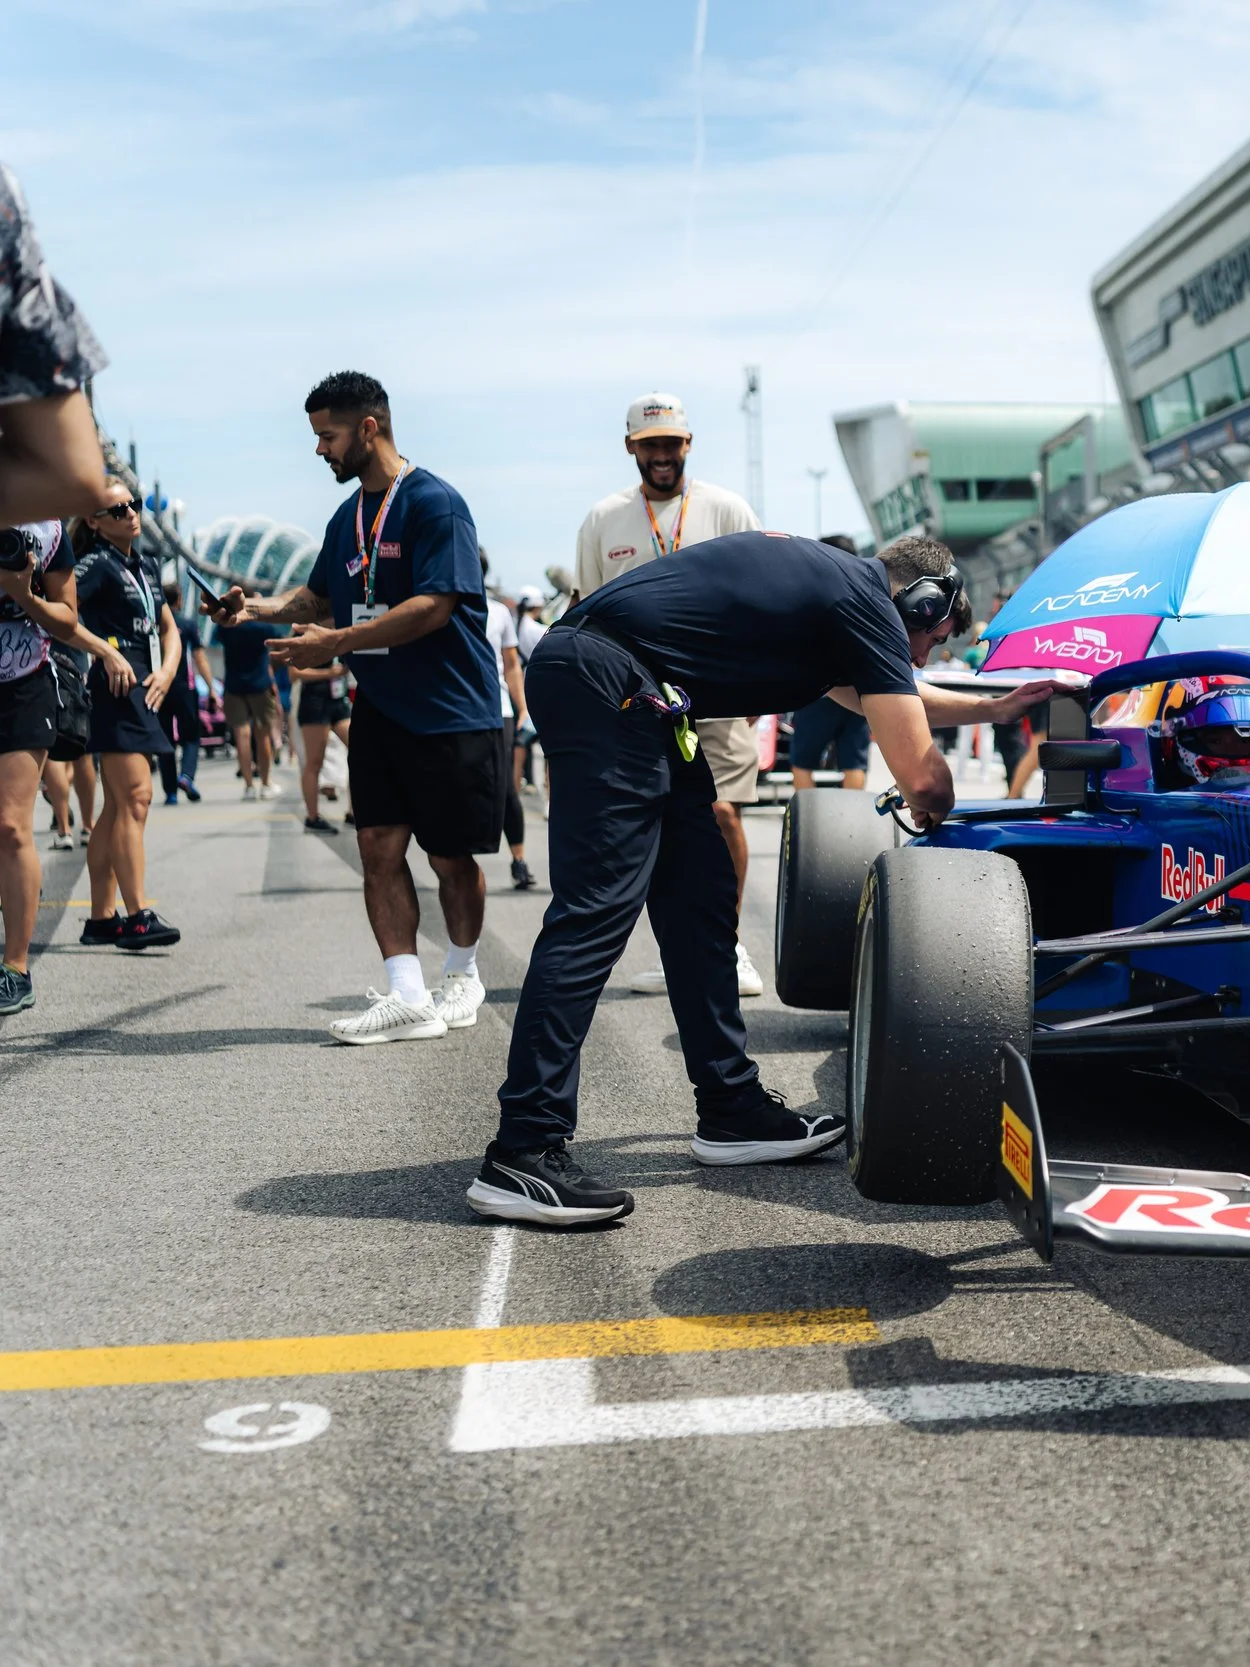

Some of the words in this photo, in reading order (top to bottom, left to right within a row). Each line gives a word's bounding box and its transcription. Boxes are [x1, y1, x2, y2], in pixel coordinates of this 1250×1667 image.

[1031, 582, 1162, 613] ACADEMY
[1162, 844, 1194, 903] Red
[1005, 1120, 1030, 1184] PIRELLI
